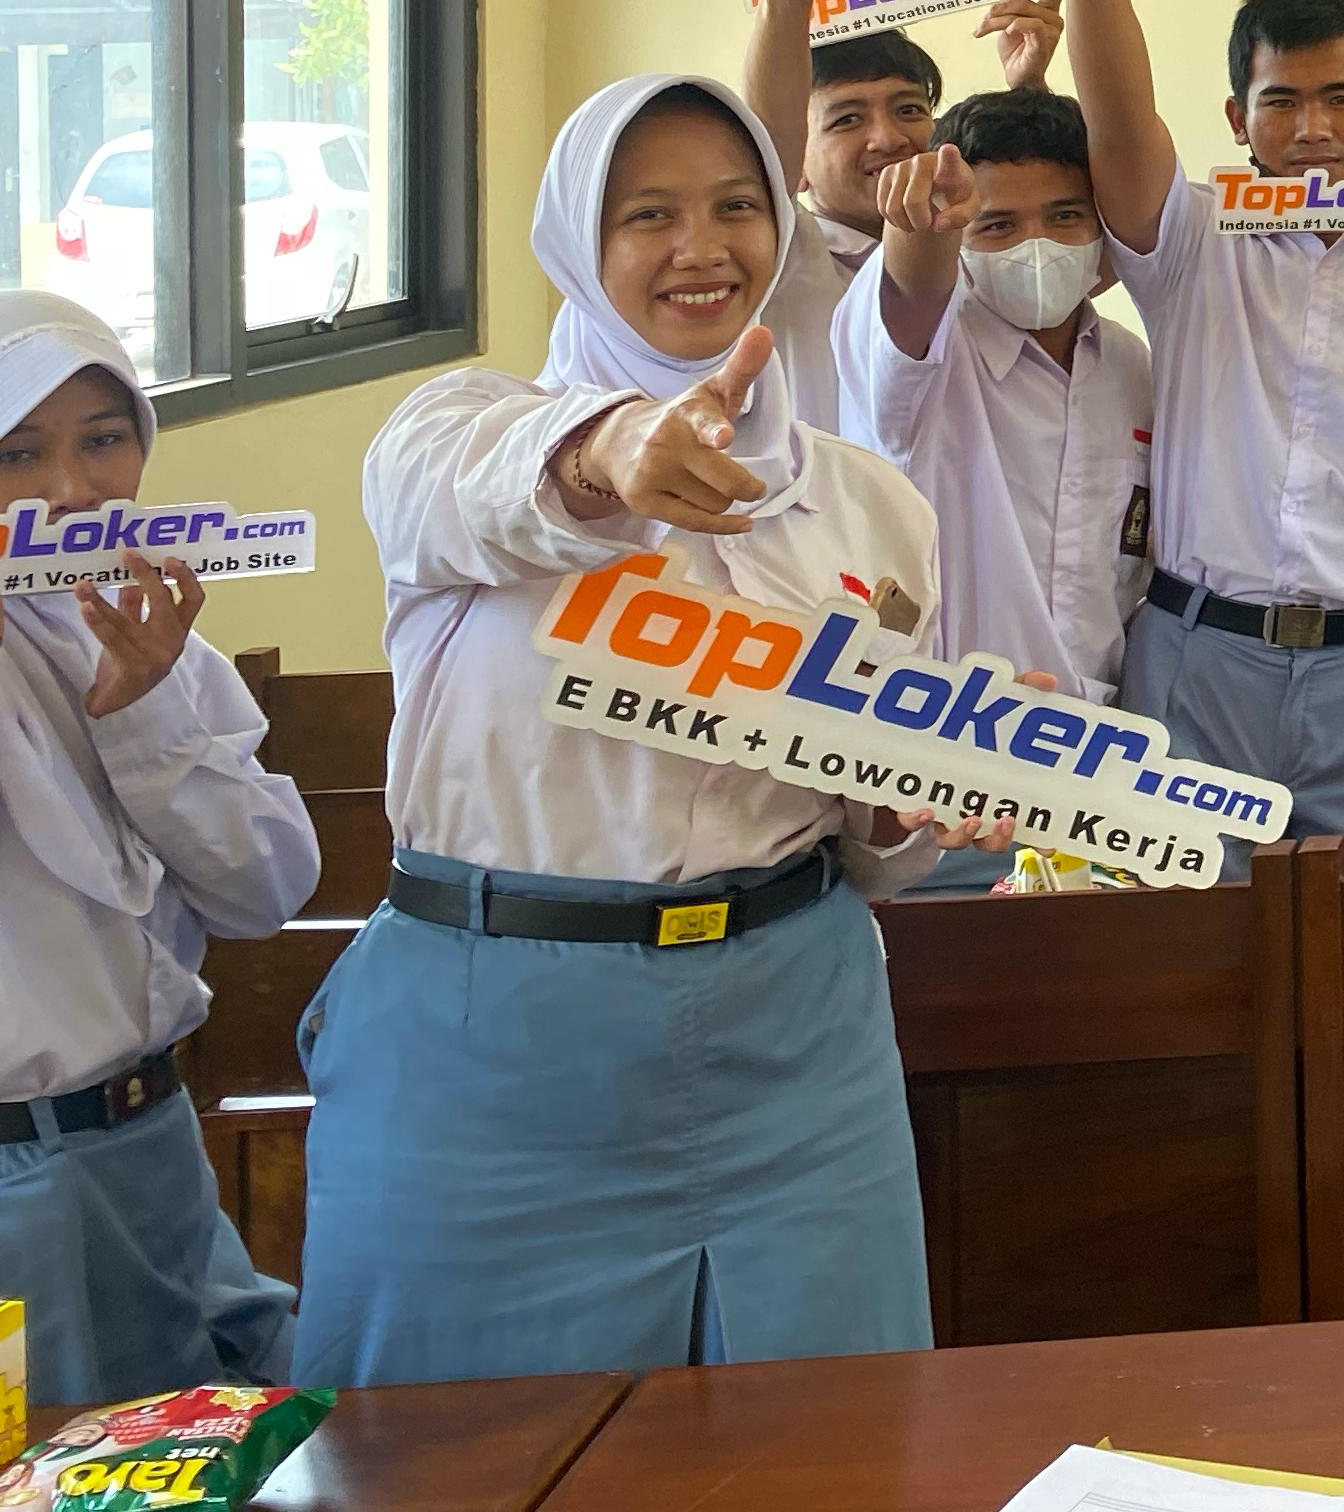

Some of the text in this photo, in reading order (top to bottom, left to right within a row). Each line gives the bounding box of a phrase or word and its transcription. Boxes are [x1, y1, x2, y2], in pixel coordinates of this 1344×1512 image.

[852, 18, 872, 30] #1
[1219, 220, 1299, 231] Indonesia
[1303, 219, 1321, 229] #1
[0, 509, 305, 558] Loker.com
[4, 573, 34, 590] #1
[195, 558, 239, 573] Job
[247, 552, 296, 569] Site
[549, 553, 1271, 826] TopLoker.com
[556, 675, 593, 710] E
[605, 688, 728, 746] BKK
[784, 735, 1051, 832] Lowongan
[1068, 810, 1204, 873] Kerja
[57, 1458, 209, 1500] Taro
